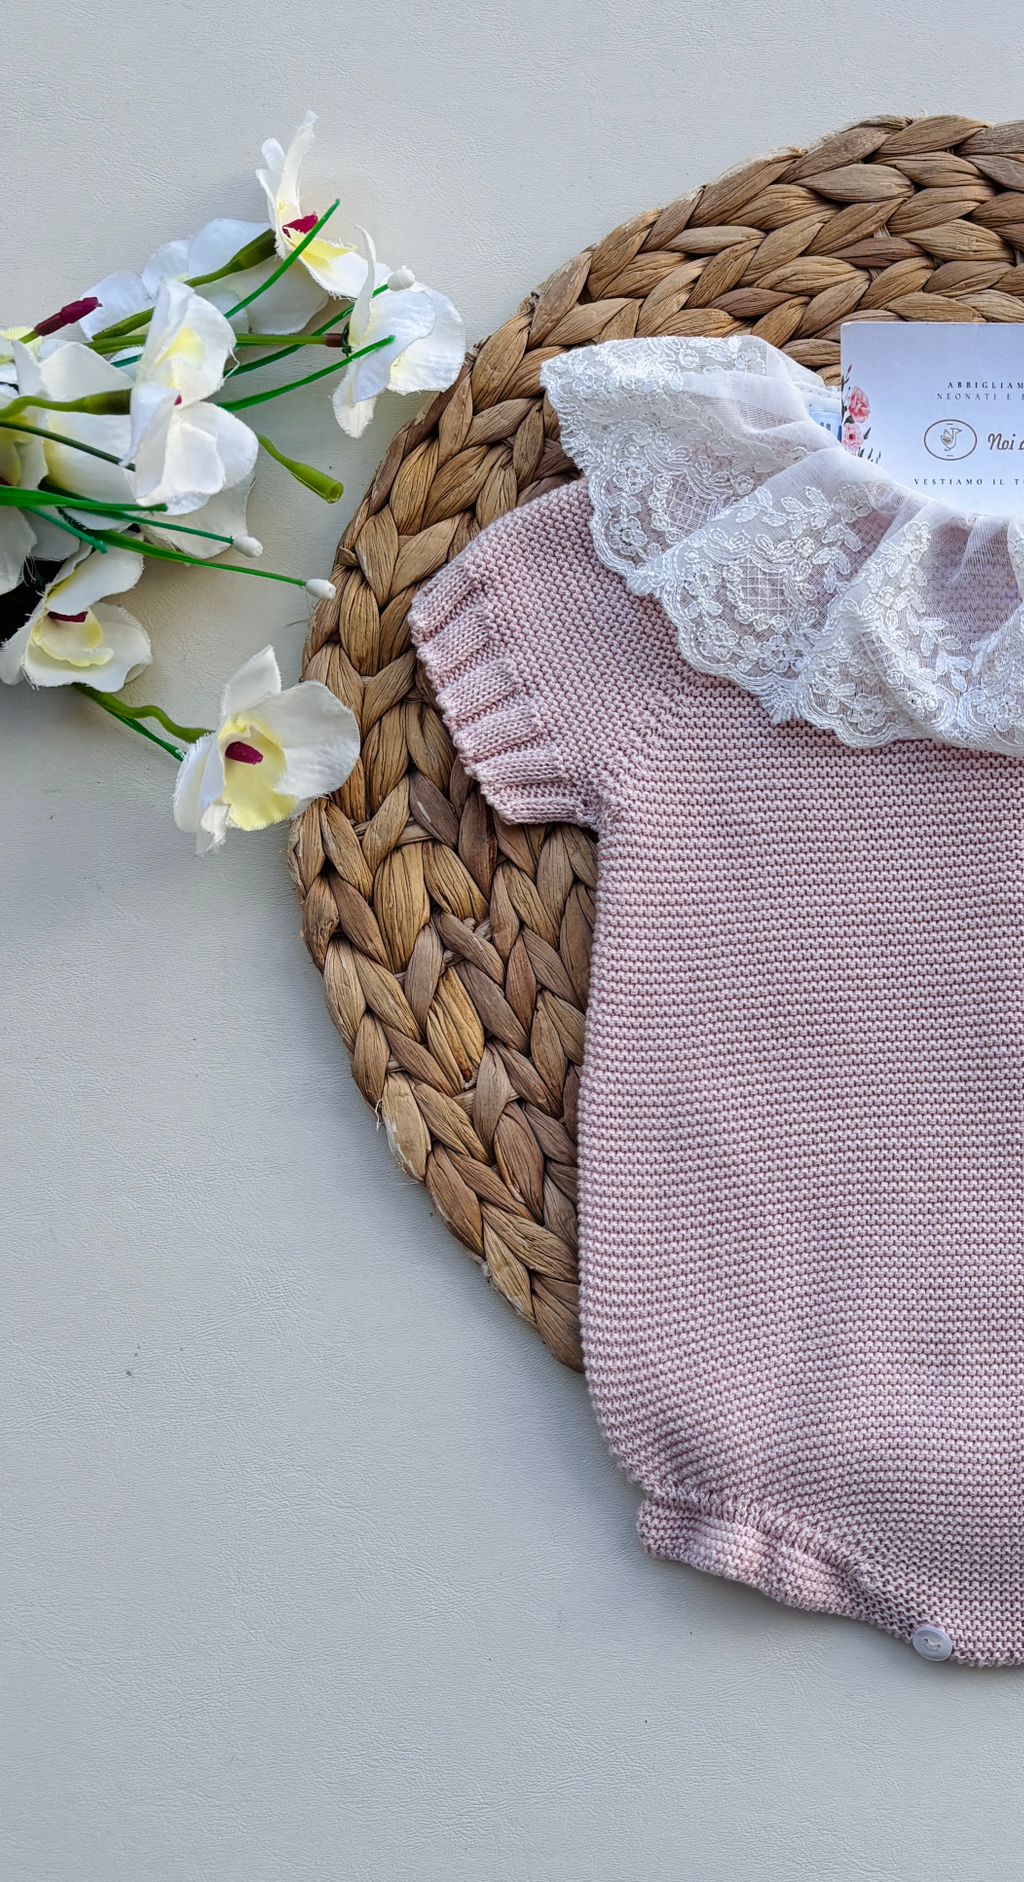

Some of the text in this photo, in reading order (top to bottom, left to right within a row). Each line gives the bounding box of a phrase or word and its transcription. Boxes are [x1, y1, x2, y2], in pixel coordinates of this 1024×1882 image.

[936, 393, 997, 401] NEONATI
[1006, 393, 1012, 401] E
[987, 433, 1016, 451] Noi
[914, 478, 983, 486] VESTIAMO
[992, 478, 1005, 486] IL
